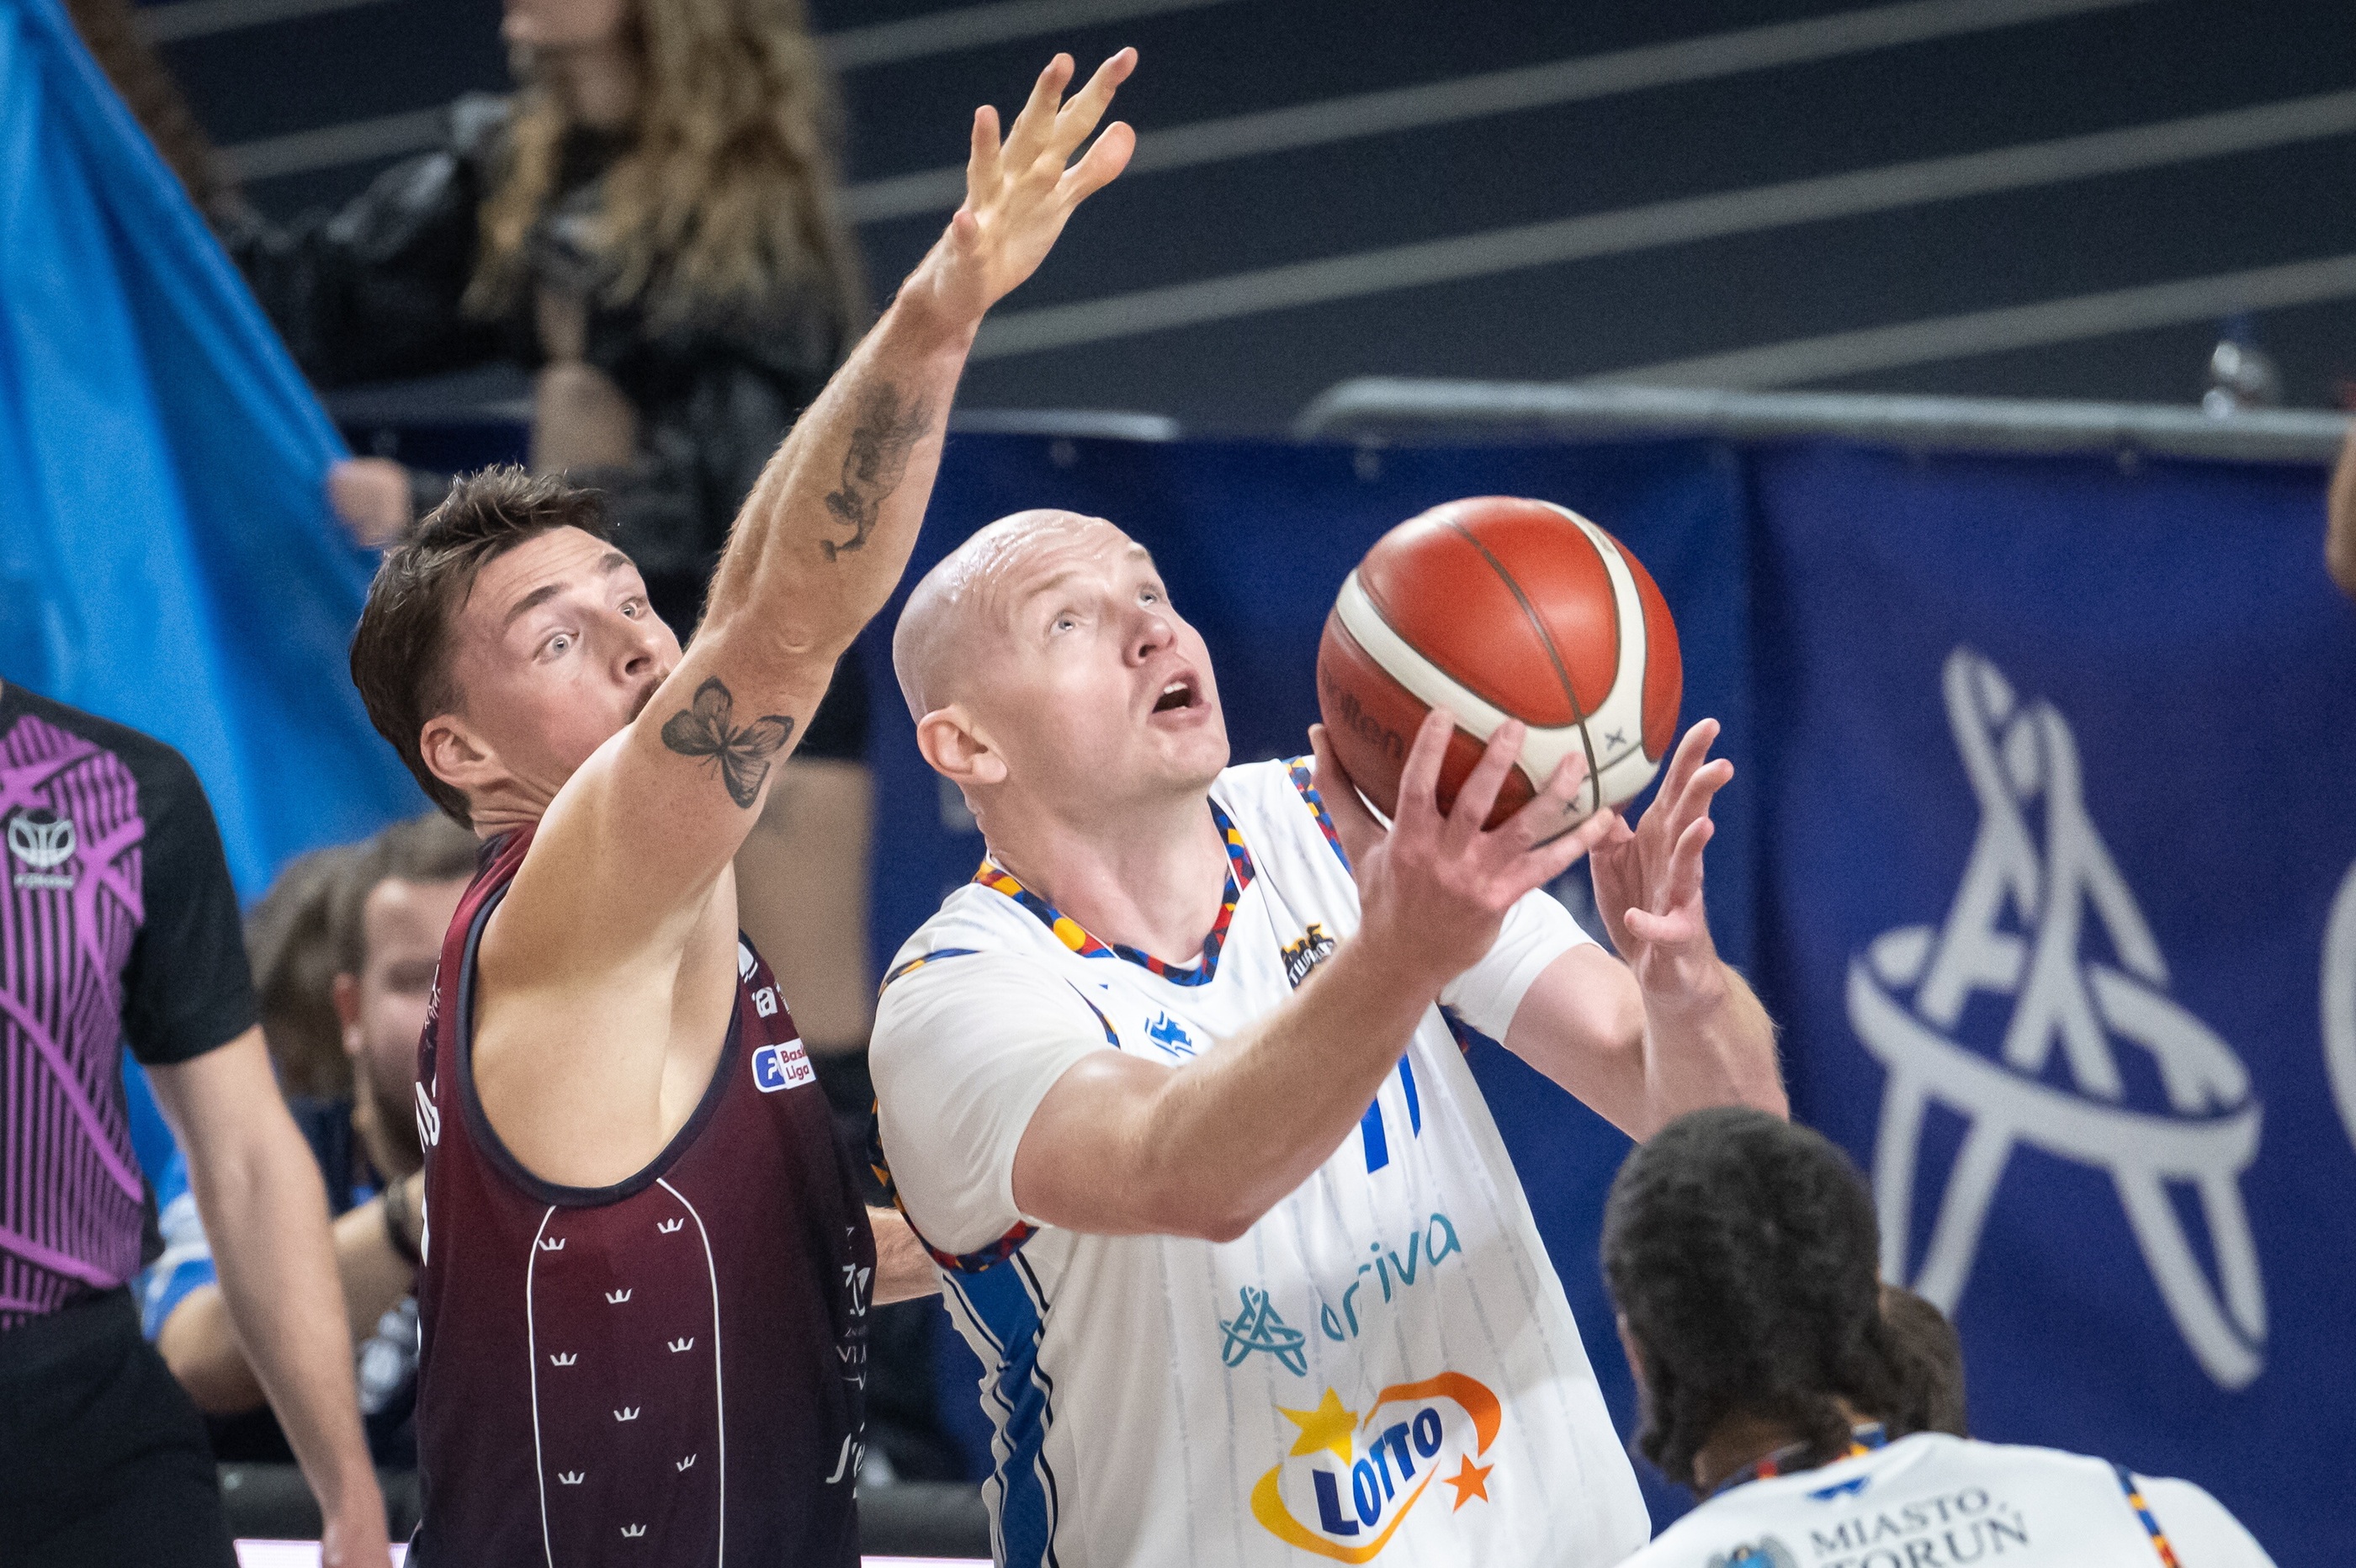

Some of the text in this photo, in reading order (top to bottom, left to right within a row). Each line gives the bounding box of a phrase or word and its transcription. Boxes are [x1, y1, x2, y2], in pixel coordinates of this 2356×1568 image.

[786, 1063, 809, 1080] Liga
[1312, 1406, 1443, 1536] LOTTO
[1809, 1486, 1990, 1557] MIASTO
